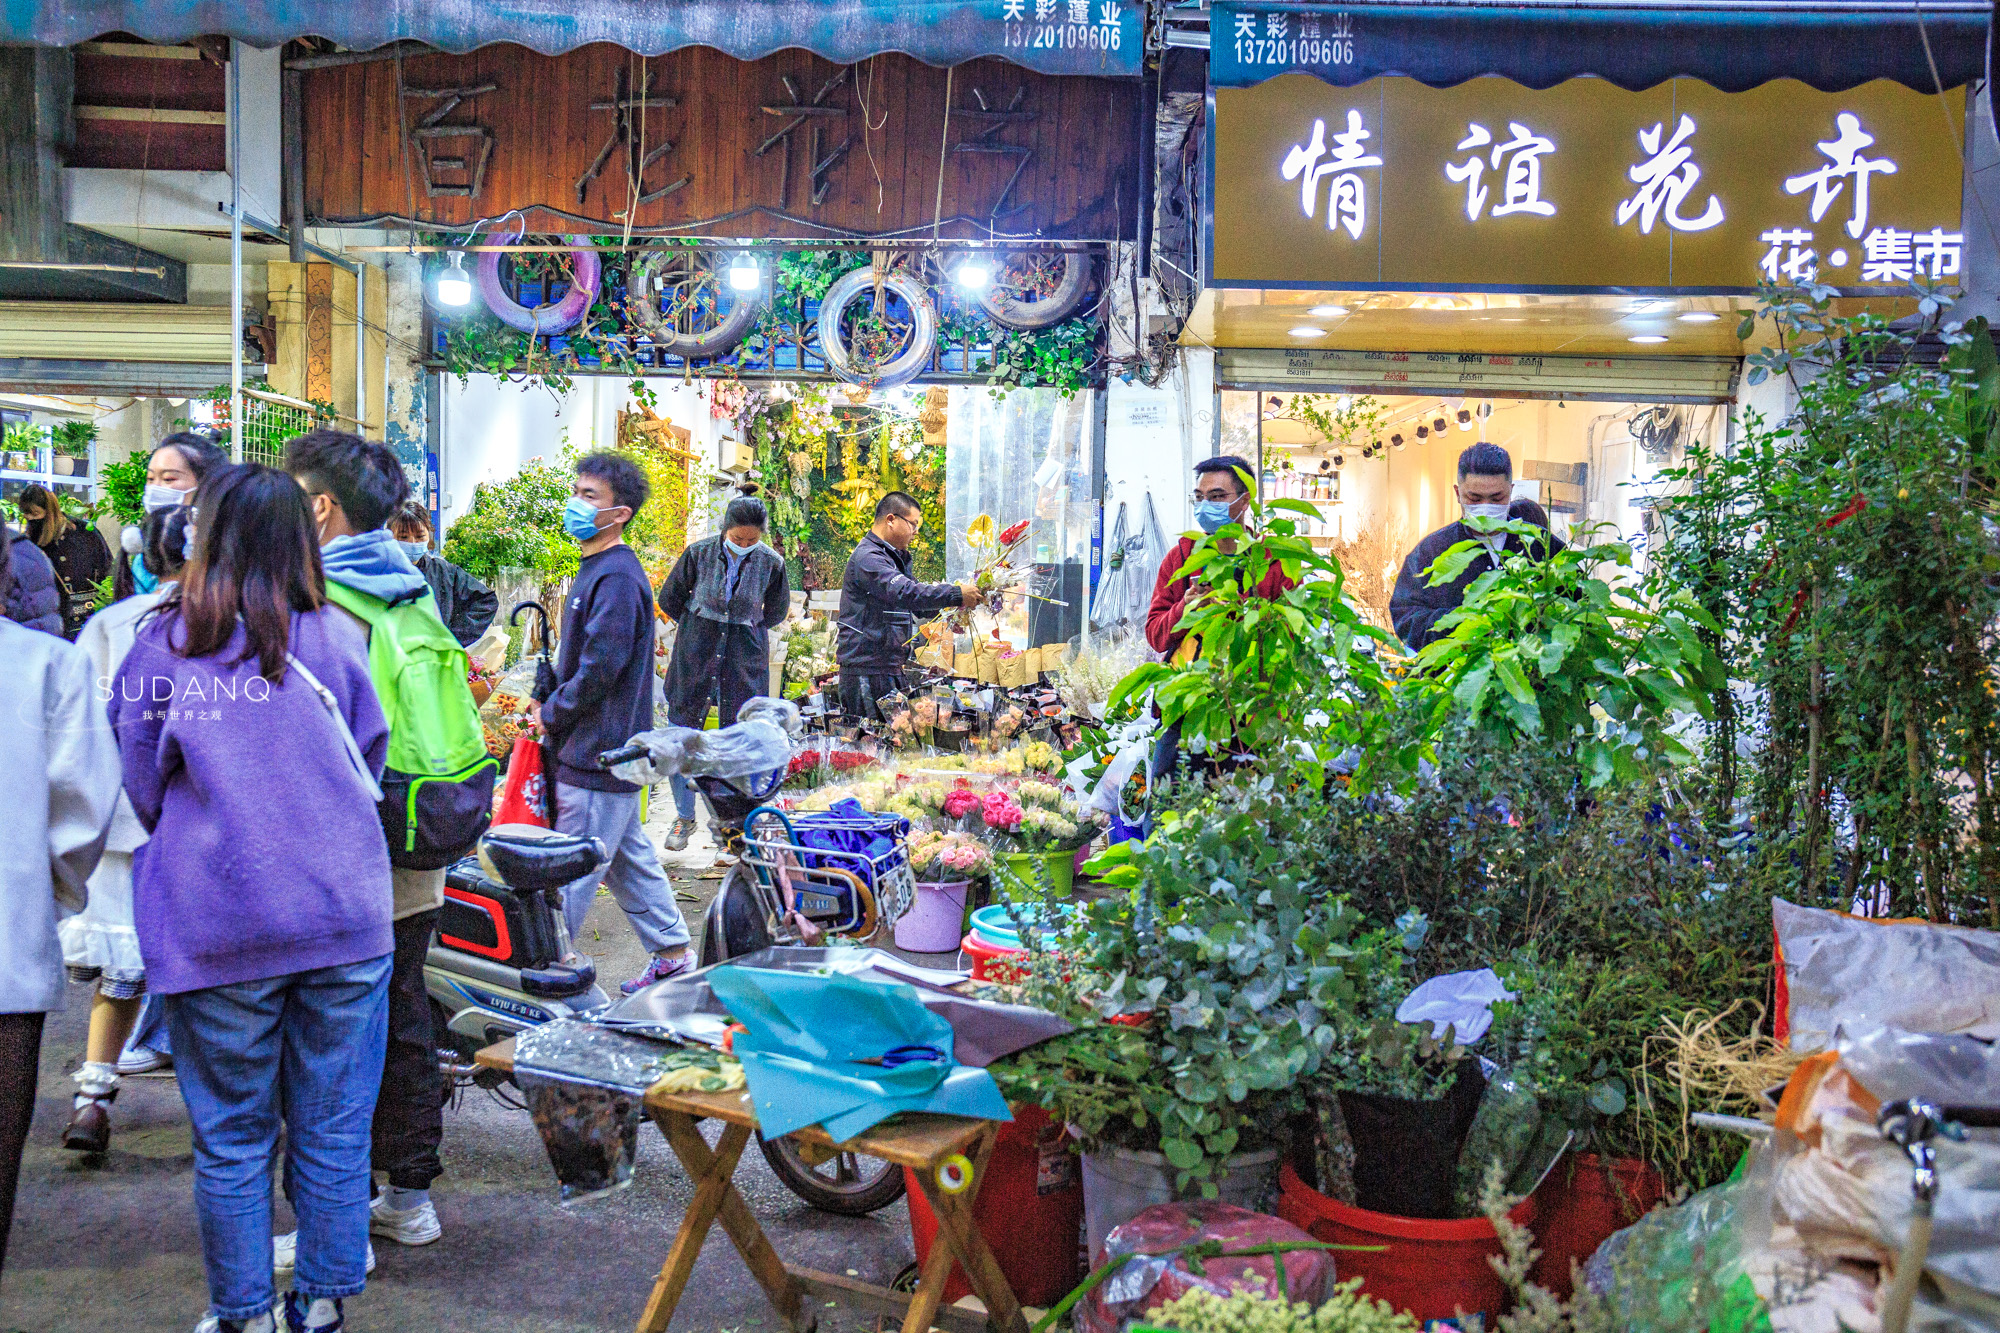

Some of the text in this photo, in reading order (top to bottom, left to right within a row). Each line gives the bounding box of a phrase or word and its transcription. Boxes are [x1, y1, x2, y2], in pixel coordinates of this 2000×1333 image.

[1004, 22, 1121, 51] 13720109606
[1234, 39, 1354, 65] 13720109606
[1282, 109, 1897, 240] 情谊花卉
[511, 1003, 542, 1019] E-BIKE
